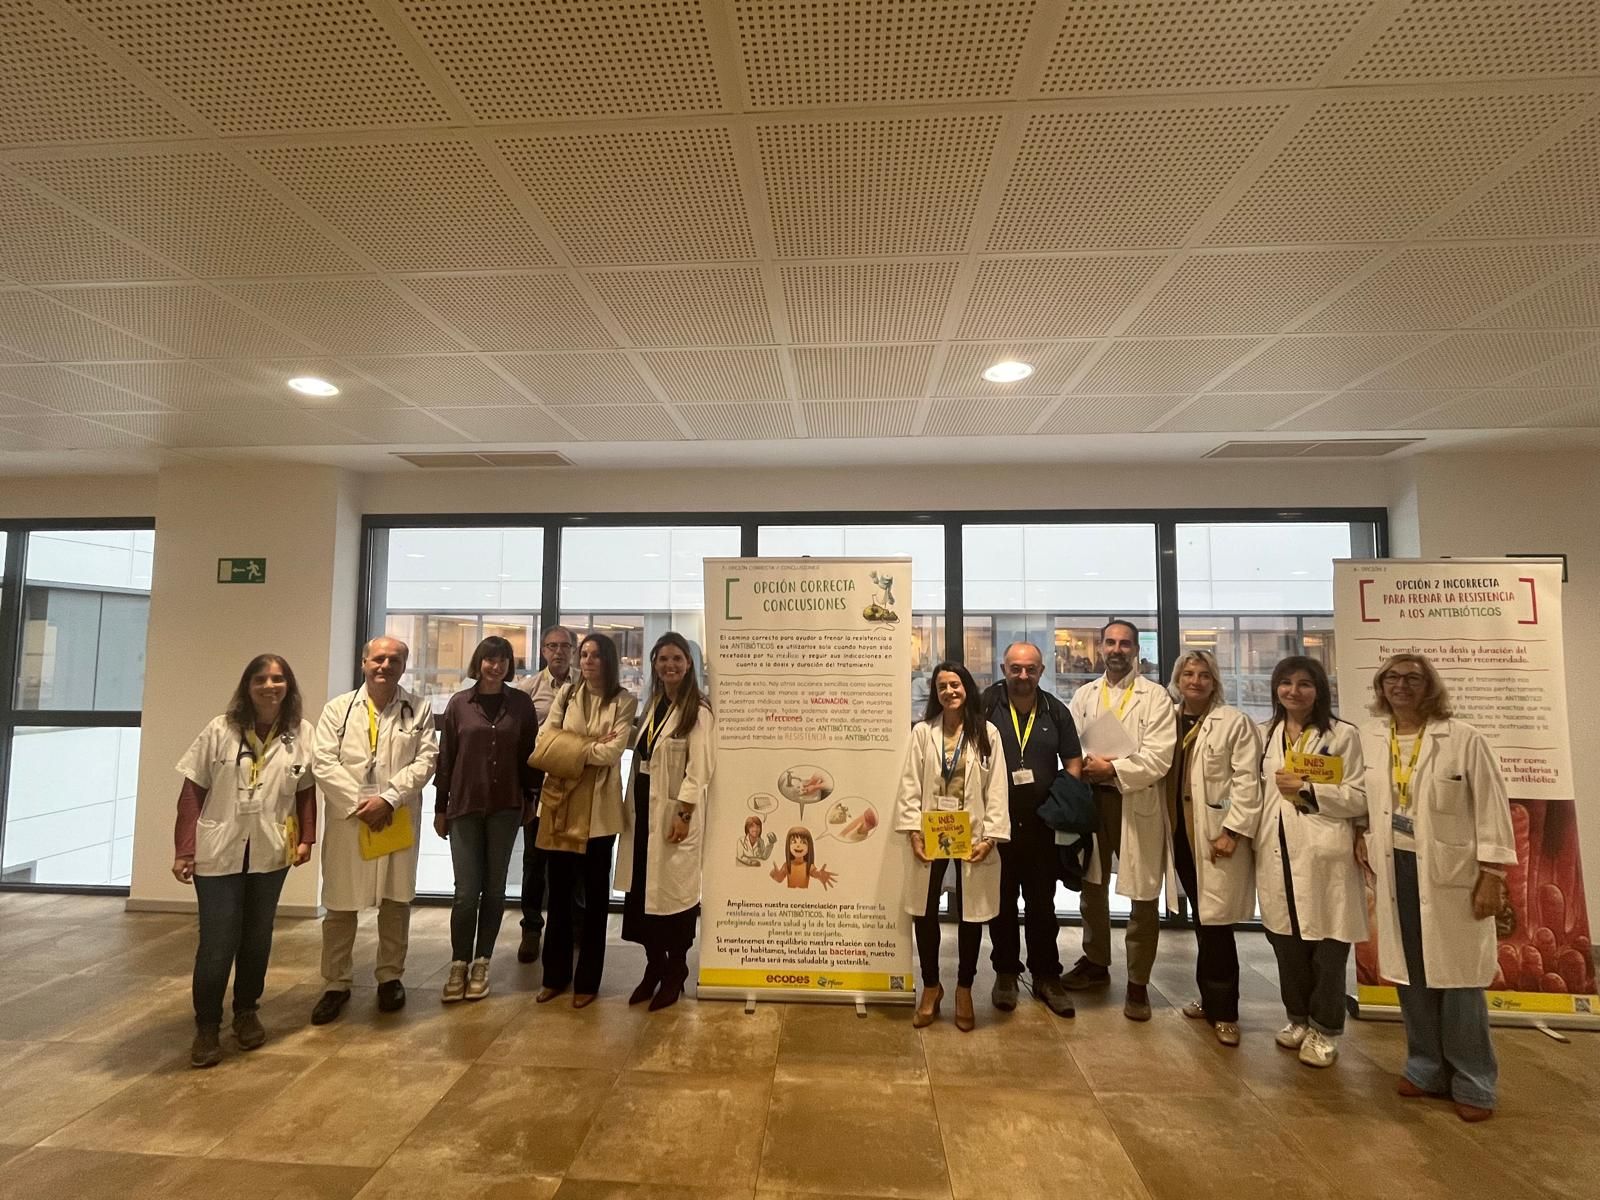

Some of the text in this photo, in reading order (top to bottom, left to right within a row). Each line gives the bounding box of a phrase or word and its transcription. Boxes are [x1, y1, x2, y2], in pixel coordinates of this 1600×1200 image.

[754, 578, 856, 594] OPCIÓN CORRECTA
[1396, 578, 1500, 590] OPCIÓN 2 INCORRECTA
[1384, 592, 1515, 604] PARA FRENAR LA RESISTENCIA
[763, 598, 846, 612] CONCLUSIONES
[1400, 605, 1502, 618] A LOS ANTIBIÓTICOS
[1380, 646, 1390, 654] No
[1392, 646, 1420, 655] cumplir
[1440, 646, 1447, 654] la
[1449, 646, 1468, 654] dosis
[1471, 648, 1476, 656] y
[1477, 645, 1514, 654] duración
[1516, 646, 1527, 654] del
[1457, 655, 1472, 663] han
[1514, 764, 1551, 773] bacterias
[727, 899, 762, 909] Ampliemos
[840, 904, 854, 912] para
[768, 929, 792, 938] planeta
[776, 938, 807, 947] equilibrio
[878, 940, 896, 948] todos
[729, 947, 740, 955] que
[750, 946, 786, 955] habitamos,
[830, 948, 868, 957] bacterias,
[741, 956, 765, 965] planeta
